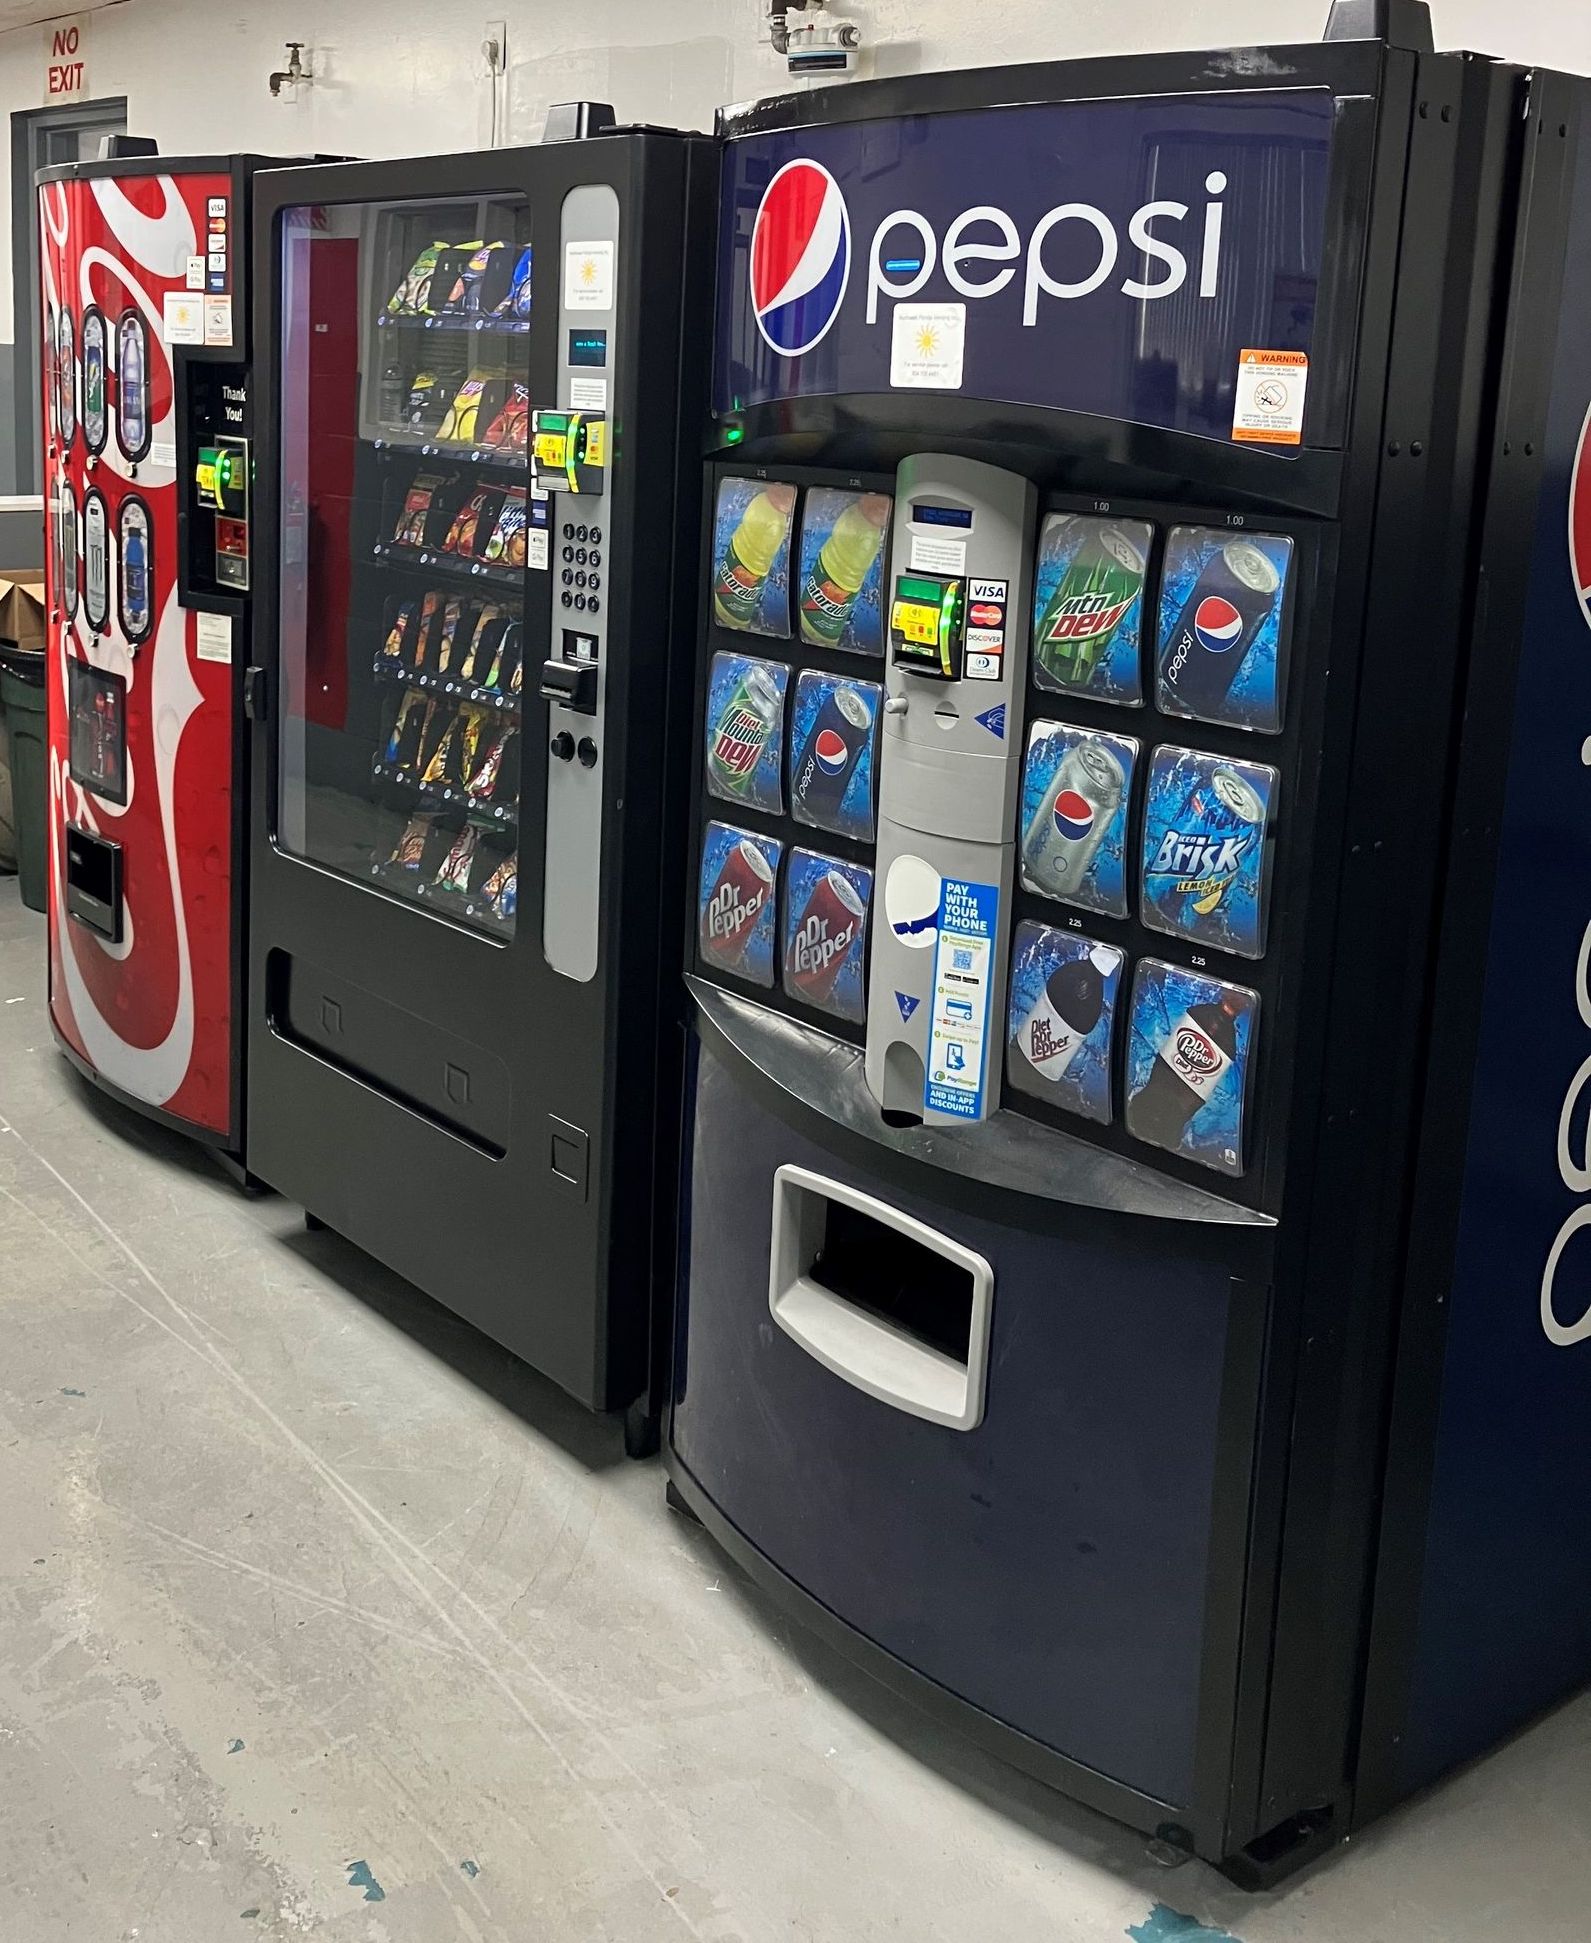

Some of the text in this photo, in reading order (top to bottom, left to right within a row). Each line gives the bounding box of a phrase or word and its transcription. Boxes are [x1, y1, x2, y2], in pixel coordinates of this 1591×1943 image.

[53, 27, 79, 57] NO
[49, 63, 84, 93] EXIT
[866, 171, 1228, 326] pepsi
[1261, 354, 1306, 364] WARNING
[222, 385, 246, 402] Thank
[225, 406, 243, 422] You!
[1094, 501, 1109, 512] 1.00
[1225, 514, 1244, 527] 1.00
[807, 575, 850, 618] Gatorad
[974, 585, 1004, 598] VISA
[967, 634, 1001, 643] DISCOVER
[1168, 629, 1194, 685] pepsi
[735, 712, 761, 730] Diet
[798, 755, 816, 800] pepsi
[946, 882, 969, 896] PAY
[1178, 879, 1213, 891] LEMON
[719, 882, 740, 910] Dr
[945, 892, 978, 908] WITH
[709, 887, 764, 938] Pepper
[945, 903, 979, 919] YOUR
[806, 915, 829, 942] Dr
[944, 914, 988, 931] PHONE
[1068, 917, 1082, 928] 2.25
[795, 920, 854, 974] Pepper
[1191, 955, 1206, 966] 2.25
[1031, 1017, 1051, 1033] Diet
[1031, 1033, 1070, 1057] Pepper
[1180, 1034, 1214, 1065] Pepper
[1193, 1039, 1209, 1054] Dr
[929, 1097, 975, 1114] DISCOUNTS
[930, 1090, 975, 1106] AND IN-APP
